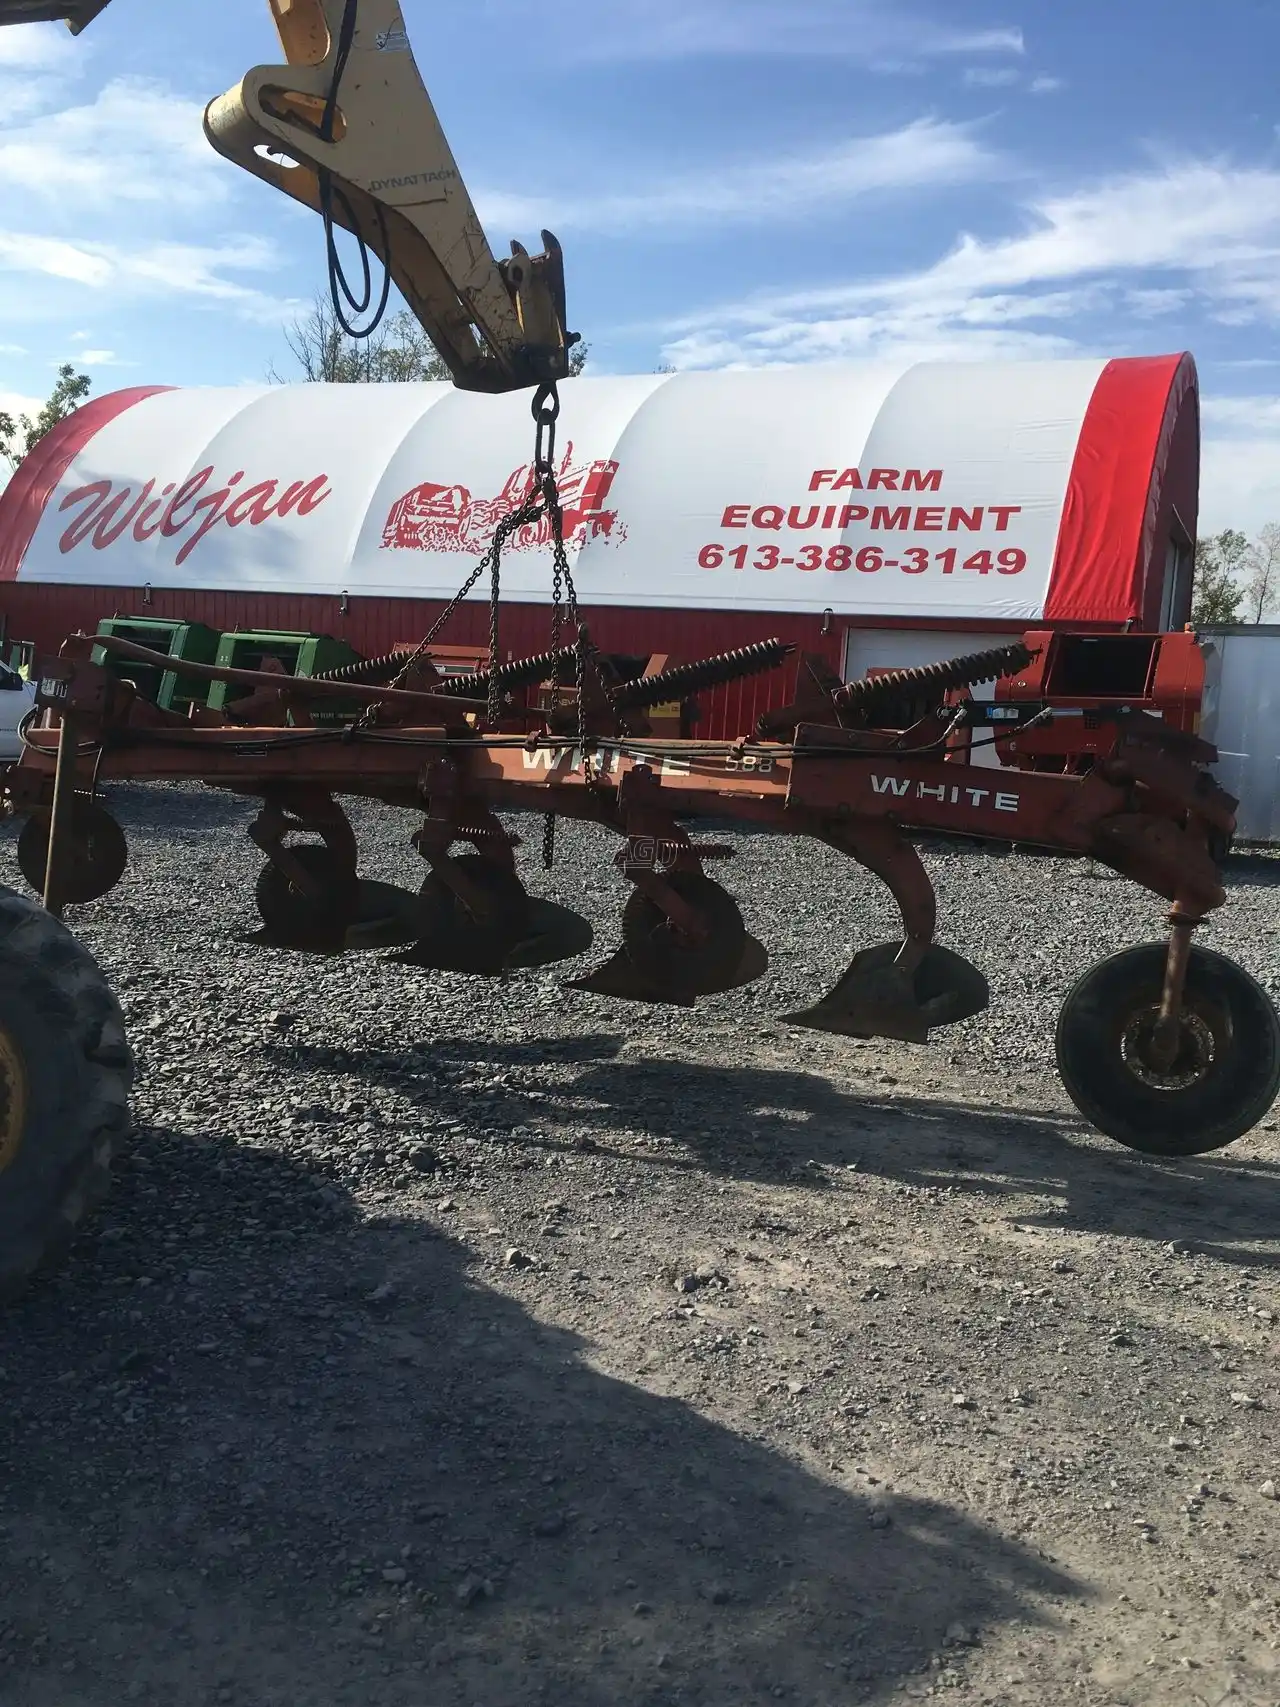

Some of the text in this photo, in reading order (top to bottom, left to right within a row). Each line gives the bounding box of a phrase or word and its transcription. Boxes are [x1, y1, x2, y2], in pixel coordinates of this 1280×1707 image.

[370, 169, 457, 191] DYNATTACH
[808, 467, 943, 491] FARM
[58, 465, 332, 566] Wiljan
[720, 505, 1022, 531] EQUIPMENT
[697, 544, 1027, 574] 613-386-3149
[870, 774, 1020, 812] WHITE
